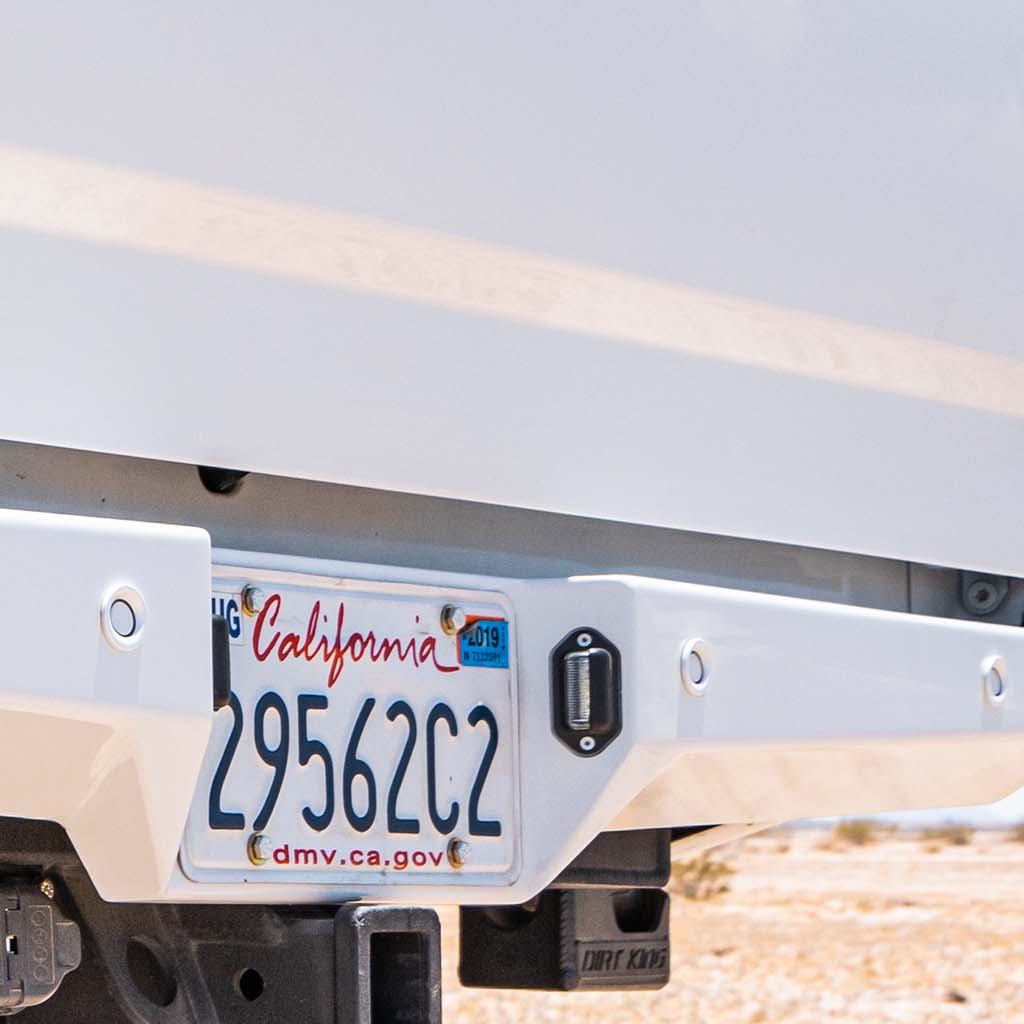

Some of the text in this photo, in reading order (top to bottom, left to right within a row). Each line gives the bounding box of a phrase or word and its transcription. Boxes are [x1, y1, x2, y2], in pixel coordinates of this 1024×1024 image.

[252, 594, 460, 687] California
[467, 625, 500, 648] 2019
[209, 690, 502, 837] 29562C2
[272, 844, 444, 870] dmv.ca.gov
[582, 948, 624, 971] DIRT
